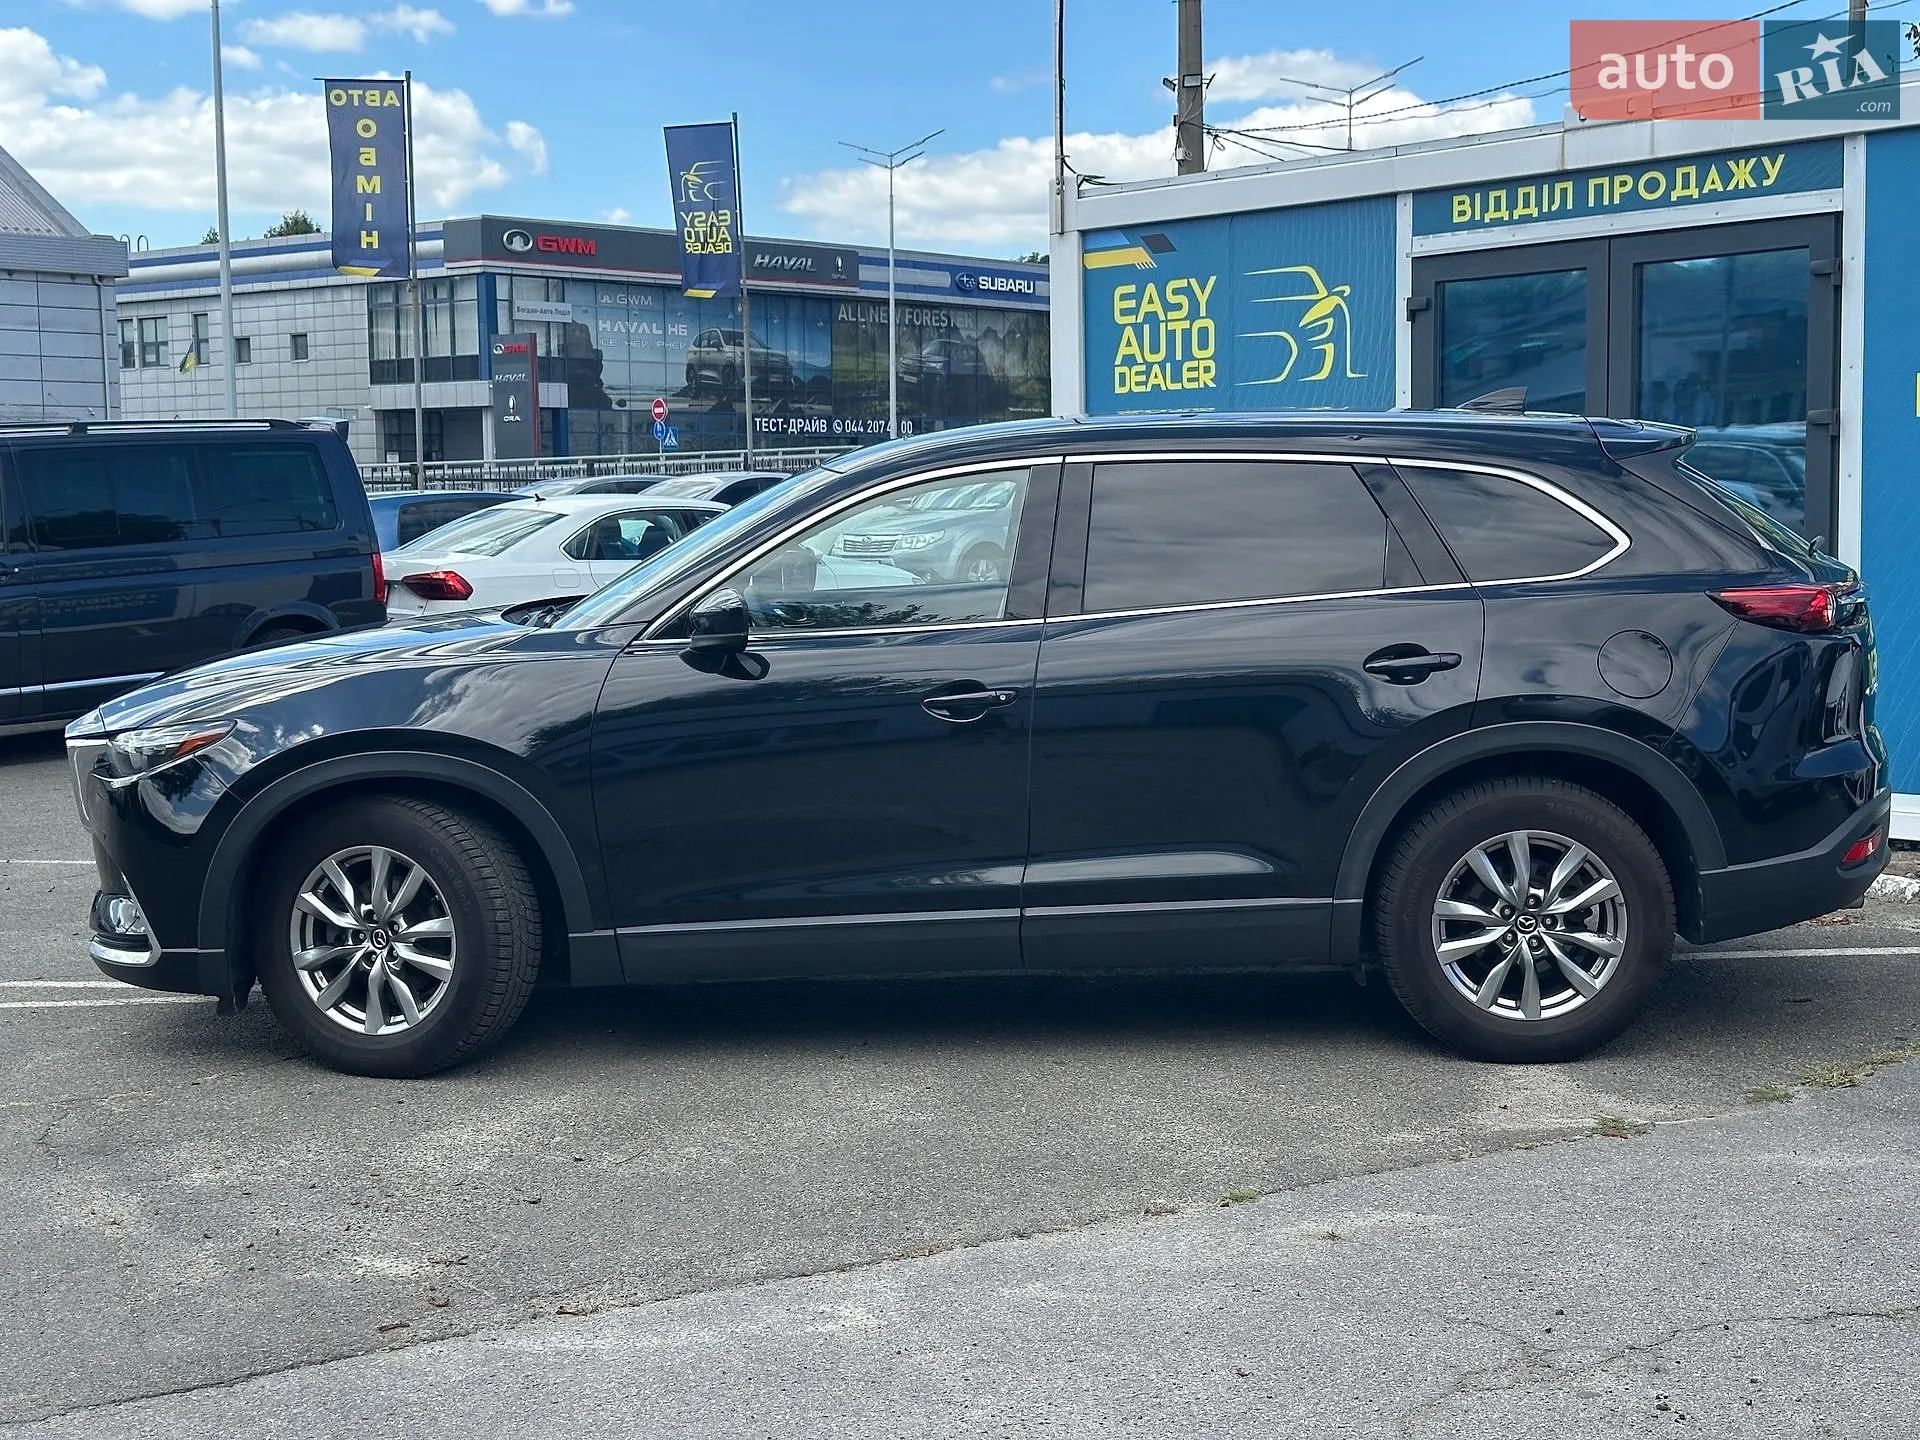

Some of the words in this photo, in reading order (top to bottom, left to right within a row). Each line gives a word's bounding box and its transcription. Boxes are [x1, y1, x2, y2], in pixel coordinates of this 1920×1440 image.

[1452, 181, 1573, 224] ВІДДІЛ
[1588, 154, 1786, 208] ПРОДАЖУ
[537, 235, 597, 255] GWM
[753, 253, 817, 272] HAVAL
[979, 276, 1034, 294] SUBARU
[617, 294, 652, 305] GWM
[1113, 275, 1217, 325] EASY
[838, 303, 866, 322] ALL
[904, 308, 976, 329] FORESTER
[599, 319, 663, 335] HAVAL
[668, 323, 688, 337] H6
[1114, 318, 1215, 366] AUTO
[495, 373, 528, 382] HAVAL
[1114, 360, 1217, 394] DEALER
[755, 417, 827, 434] ТЕСТ-ДРАЙВ
[845, 419, 864, 433] 044
